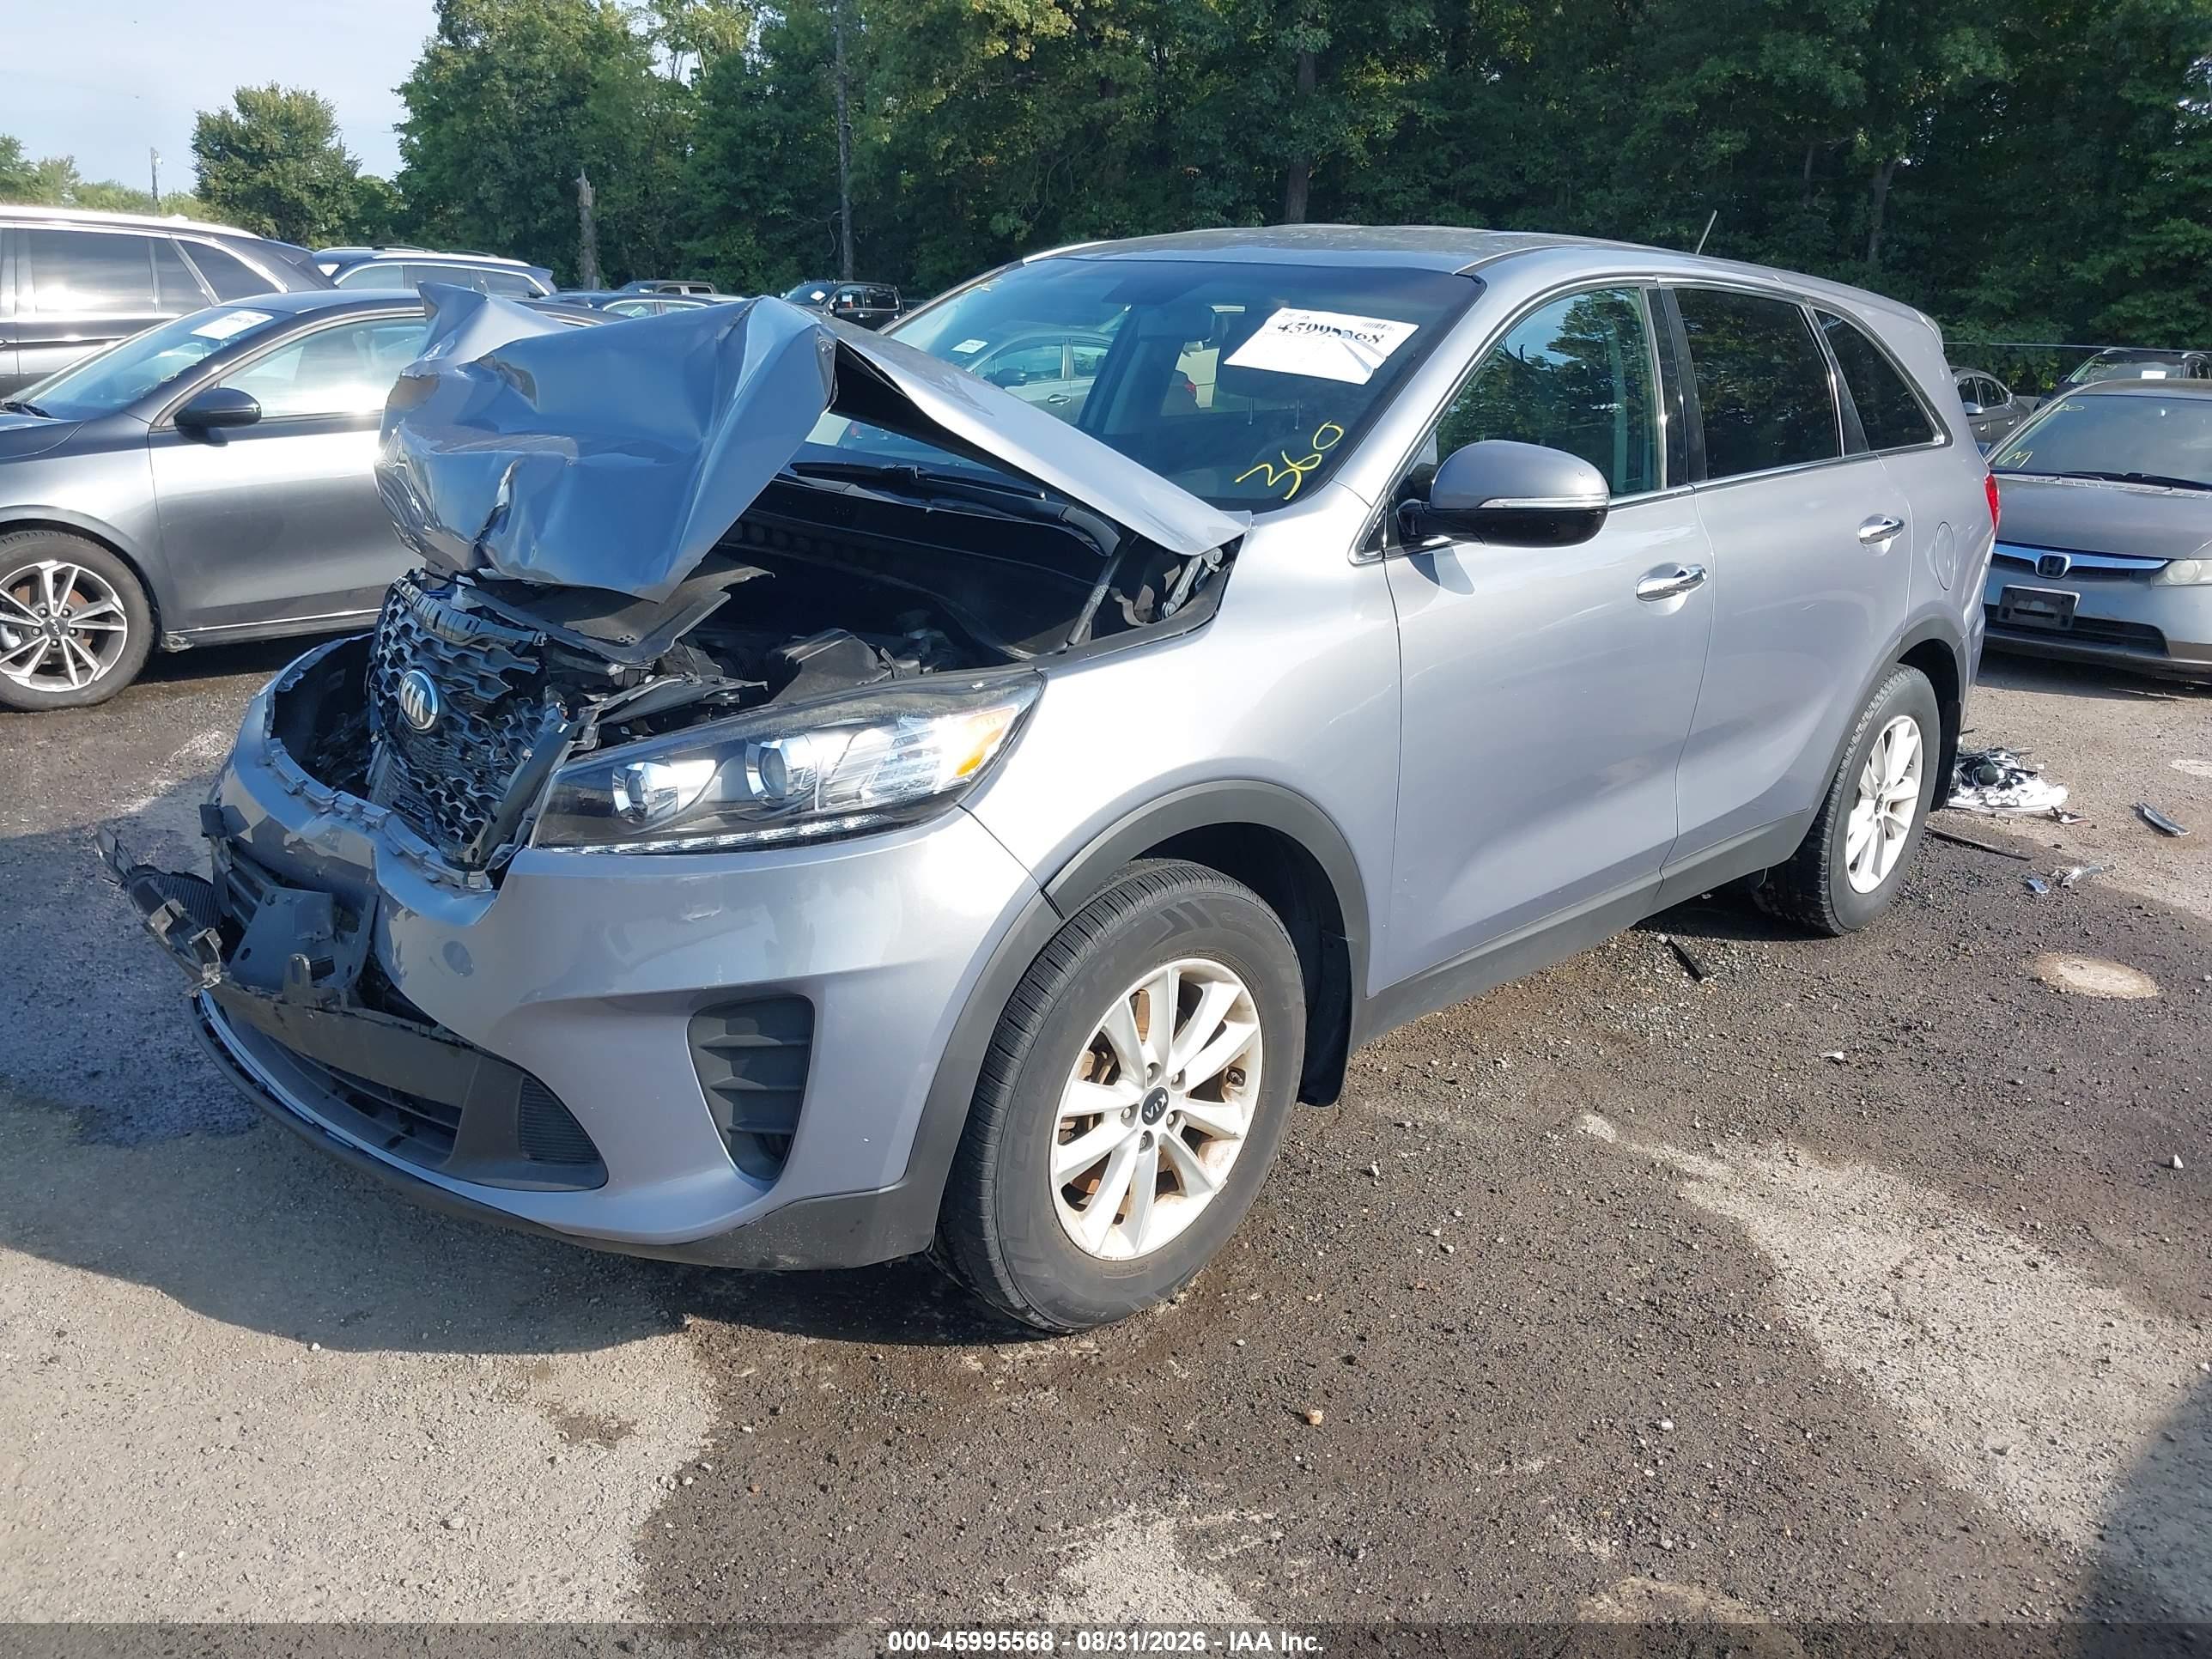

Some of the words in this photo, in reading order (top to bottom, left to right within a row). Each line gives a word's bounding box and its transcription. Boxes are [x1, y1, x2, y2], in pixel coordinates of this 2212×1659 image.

[1234, 420, 1345, 501] 360
[400, 678, 426, 723] KIA
[1144, 1093, 1168, 1119] KIA
